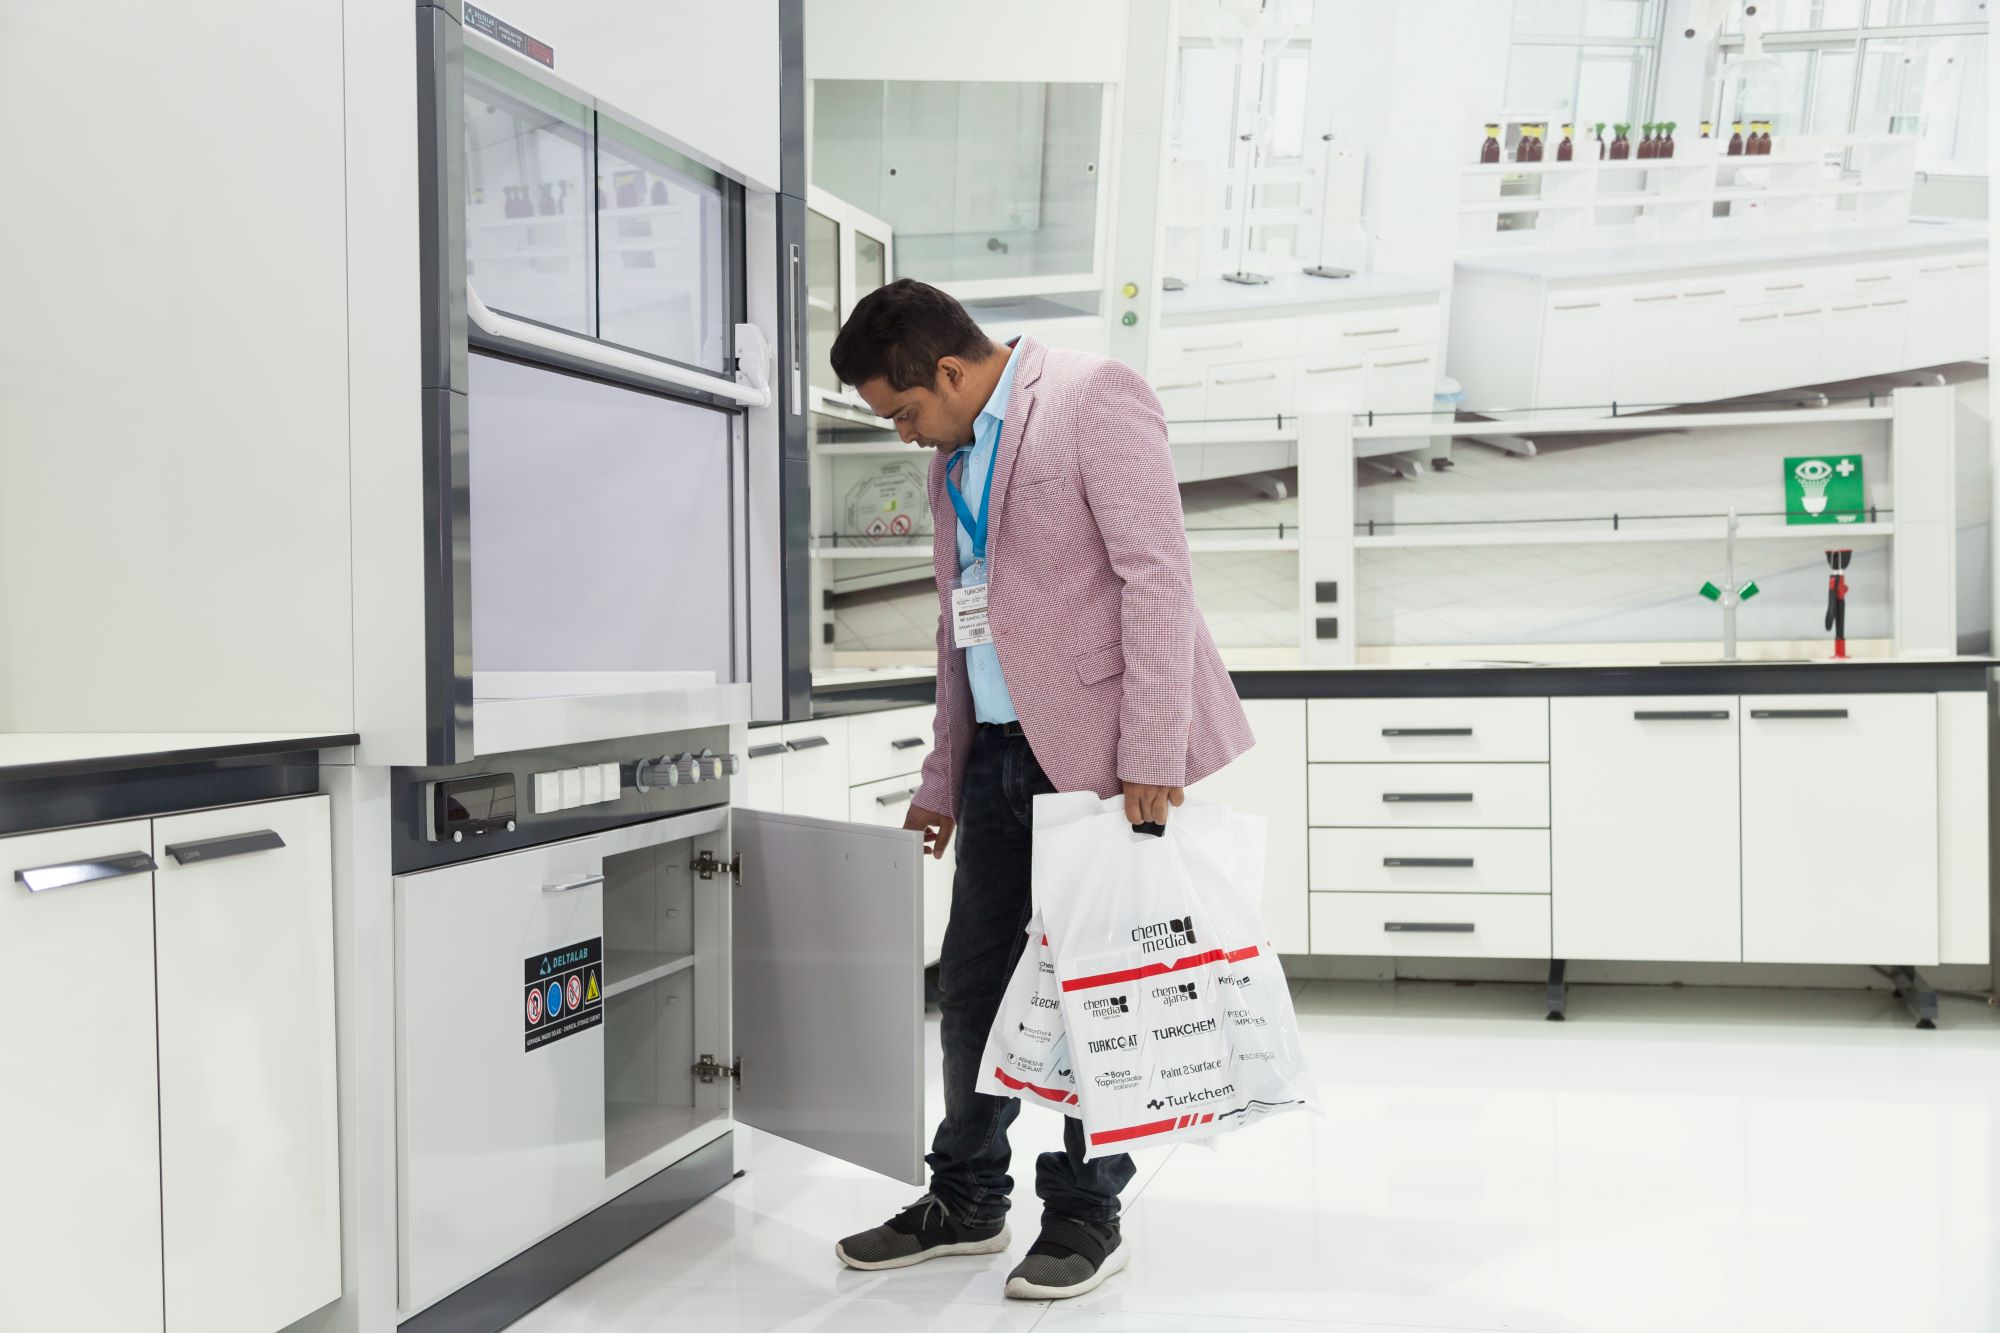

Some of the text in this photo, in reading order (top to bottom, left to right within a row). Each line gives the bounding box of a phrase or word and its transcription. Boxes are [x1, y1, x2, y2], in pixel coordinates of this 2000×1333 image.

[1131, 924, 1168, 942] chem
[1142, 934, 1187, 954] media
[553, 948, 588, 968] DELTALAB
[1151, 984, 1178, 998] chem
[1083, 998, 1110, 1011] chem
[1163, 993, 1188, 1006] ajans
[1092, 1004, 1121, 1018] media
[1152, 1018, 1217, 1041] TURKCHEM
[1088, 1034, 1138, 1054] TURKCOAT
[1110, 1069, 1131, 1079] Boya
[1189, 1059, 1222, 1073] Surface
[1165, 1084, 1235, 1107] Turkchem
